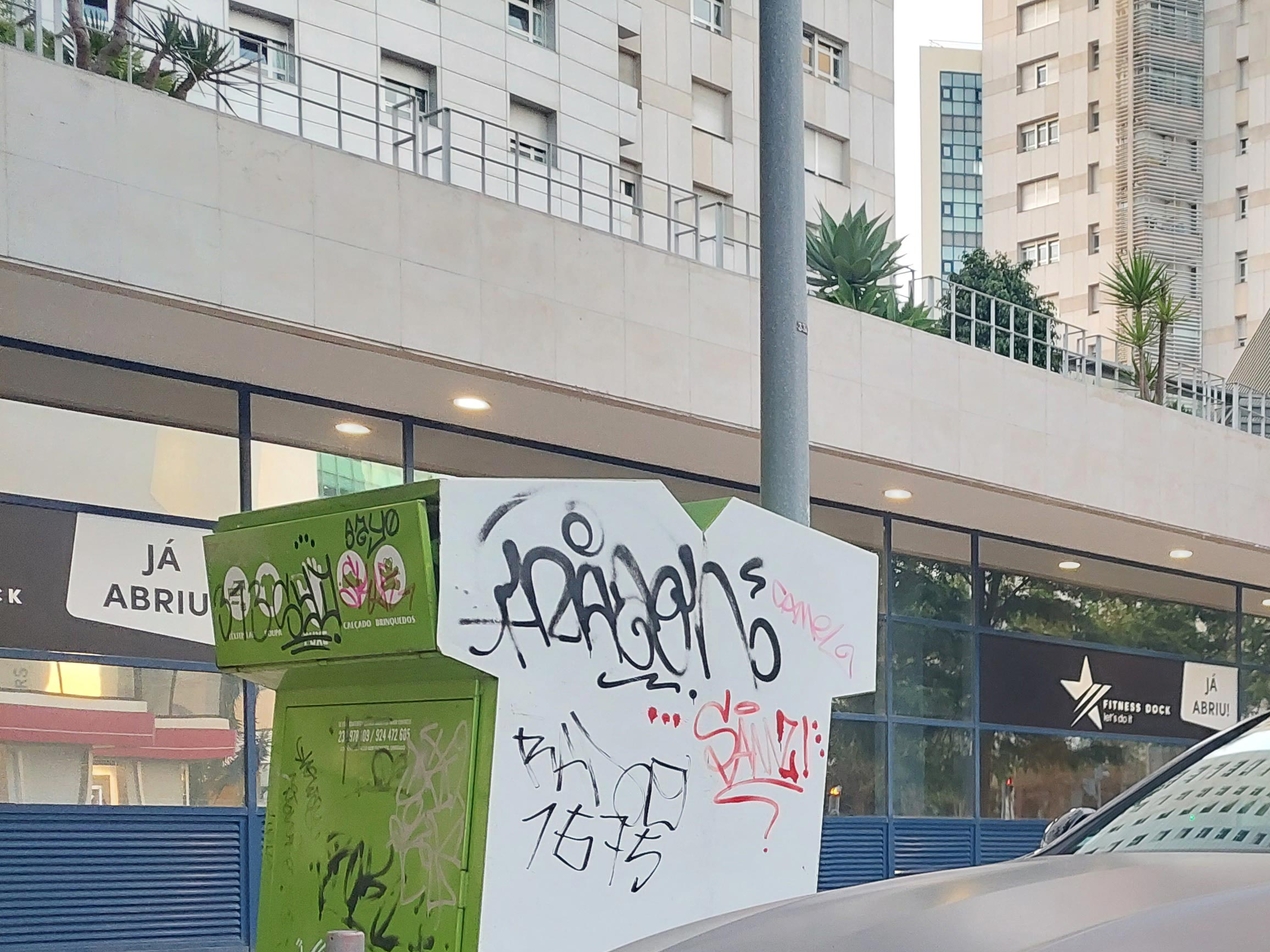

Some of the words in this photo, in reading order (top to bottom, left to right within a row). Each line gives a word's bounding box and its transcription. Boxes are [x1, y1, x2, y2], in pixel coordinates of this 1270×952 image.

[141, 538, 181, 576] JÁ
[343, 619, 372, 630] CALÇADO
[375, 615, 416, 627] BRINQUEDOS
[1205, 673, 1218, 695] JÁ
[1103, 699, 1141, 713] FITNESS
[1145, 703, 1171, 715] DOCK
[1192, 700, 1231, 717] ABRIU!
